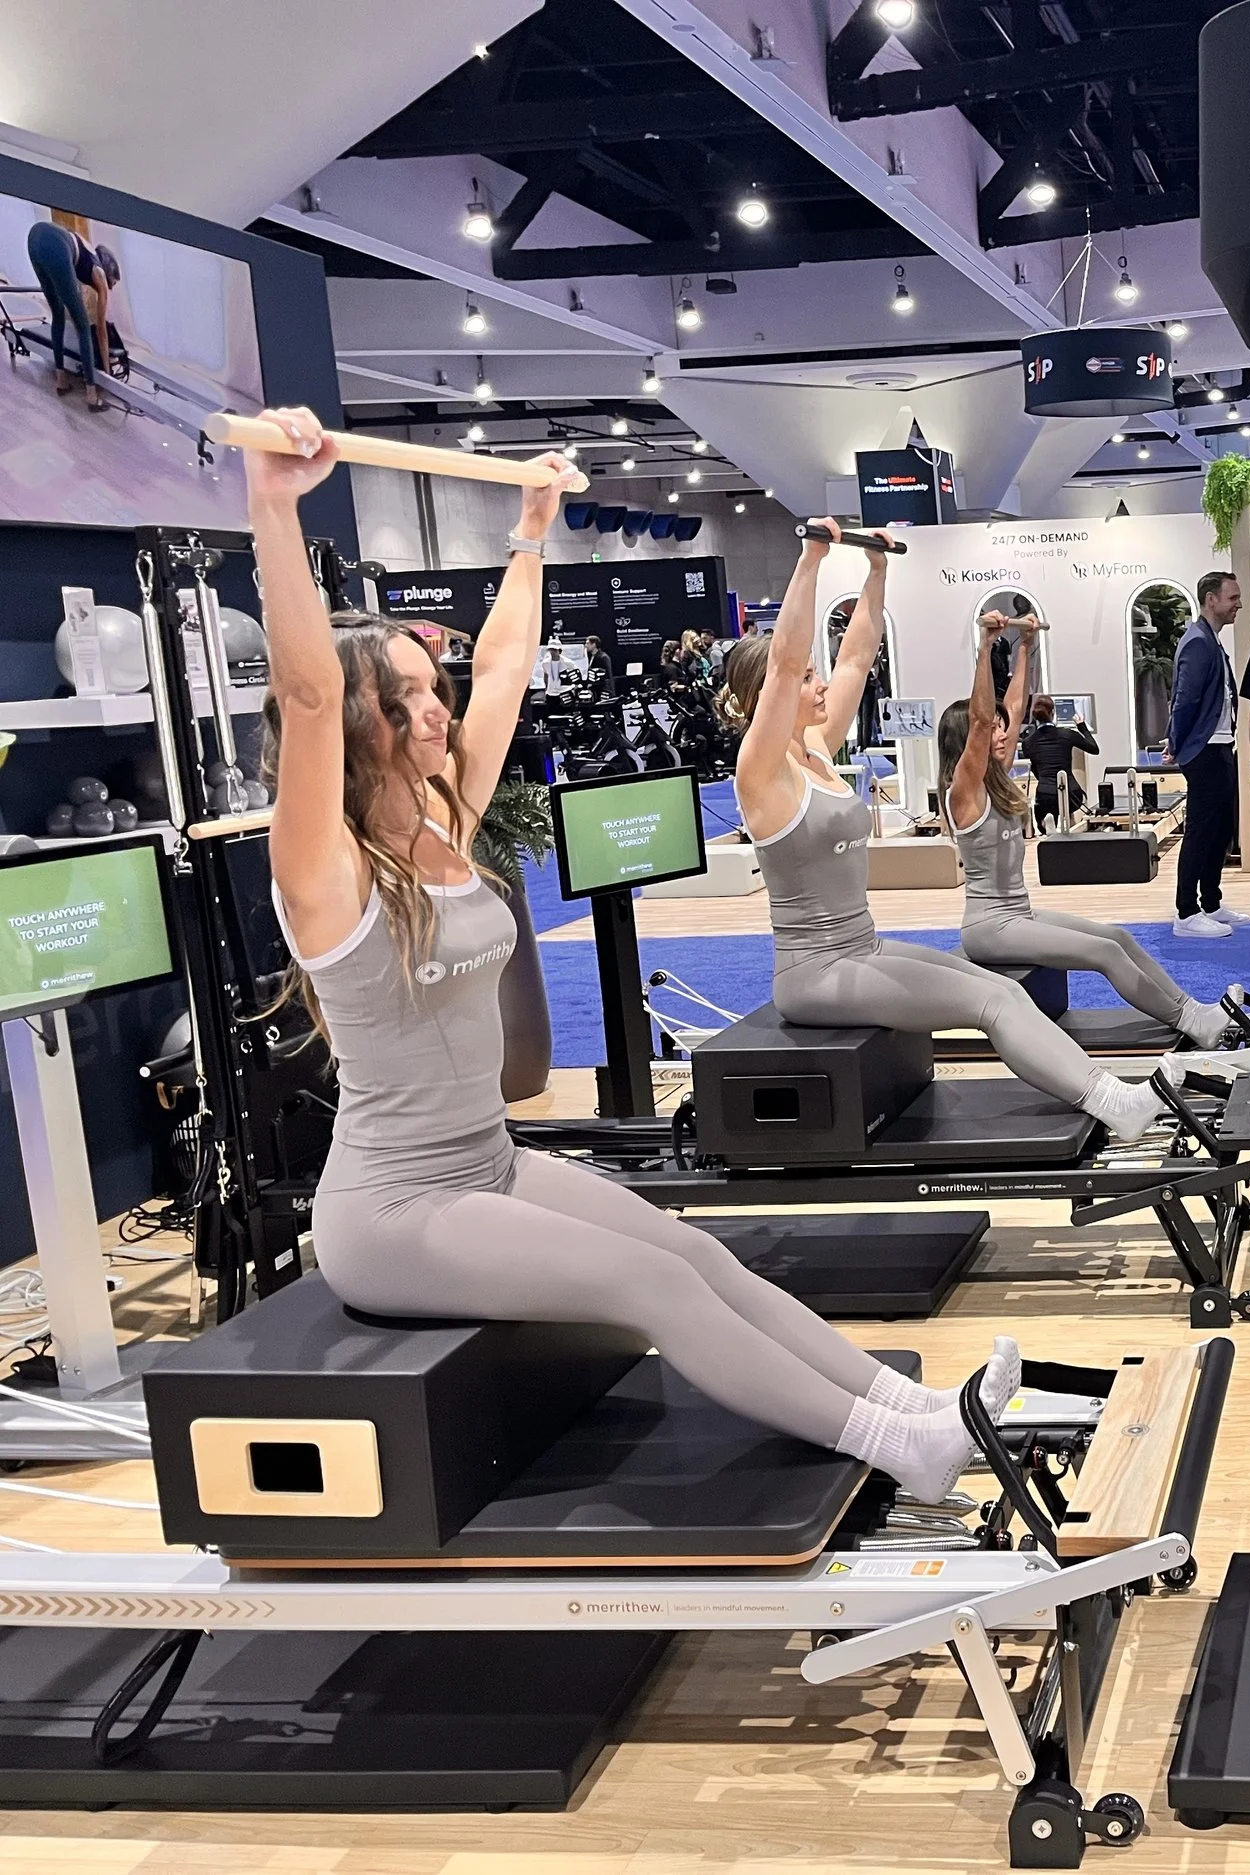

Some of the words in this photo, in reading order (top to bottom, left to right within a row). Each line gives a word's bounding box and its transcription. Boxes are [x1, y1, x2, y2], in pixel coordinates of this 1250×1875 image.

[888, 476, 916, 484] Ultimate
[864, 485, 889, 493] Fitness
[889, 483, 929, 492] Partnership
[992, 536, 1016, 546] 24/7
[1019, 532, 1089, 545] ON-DEMAND
[1014, 549, 1054, 559] Powered
[1056, 548, 1069, 558] By
[961, 569, 1021, 583] KioskPro
[1092, 563, 1147, 577] MyForm
[403, 586, 453, 602] plunge
[602, 820, 625, 830] TOUCH
[625, 813, 661, 826] ANYWHERE
[608, 831, 618, 840] TO
[618, 827, 638, 838] START
[639, 824, 657, 834] YOUR
[617, 836, 650, 848] WORKOUT
[8, 913, 45, 928] TOUCH
[47, 901, 105, 920] ANYWHERE
[20, 930, 35, 941] TO
[36, 923, 69, 938] START
[70, 917, 99, 931] YOUR
[35, 934, 89, 953] WORKOUT
[50, 971, 94, 986] merrithew
[703, 1604, 712, 1612] in
[712, 1604, 743, 1612] mindful
